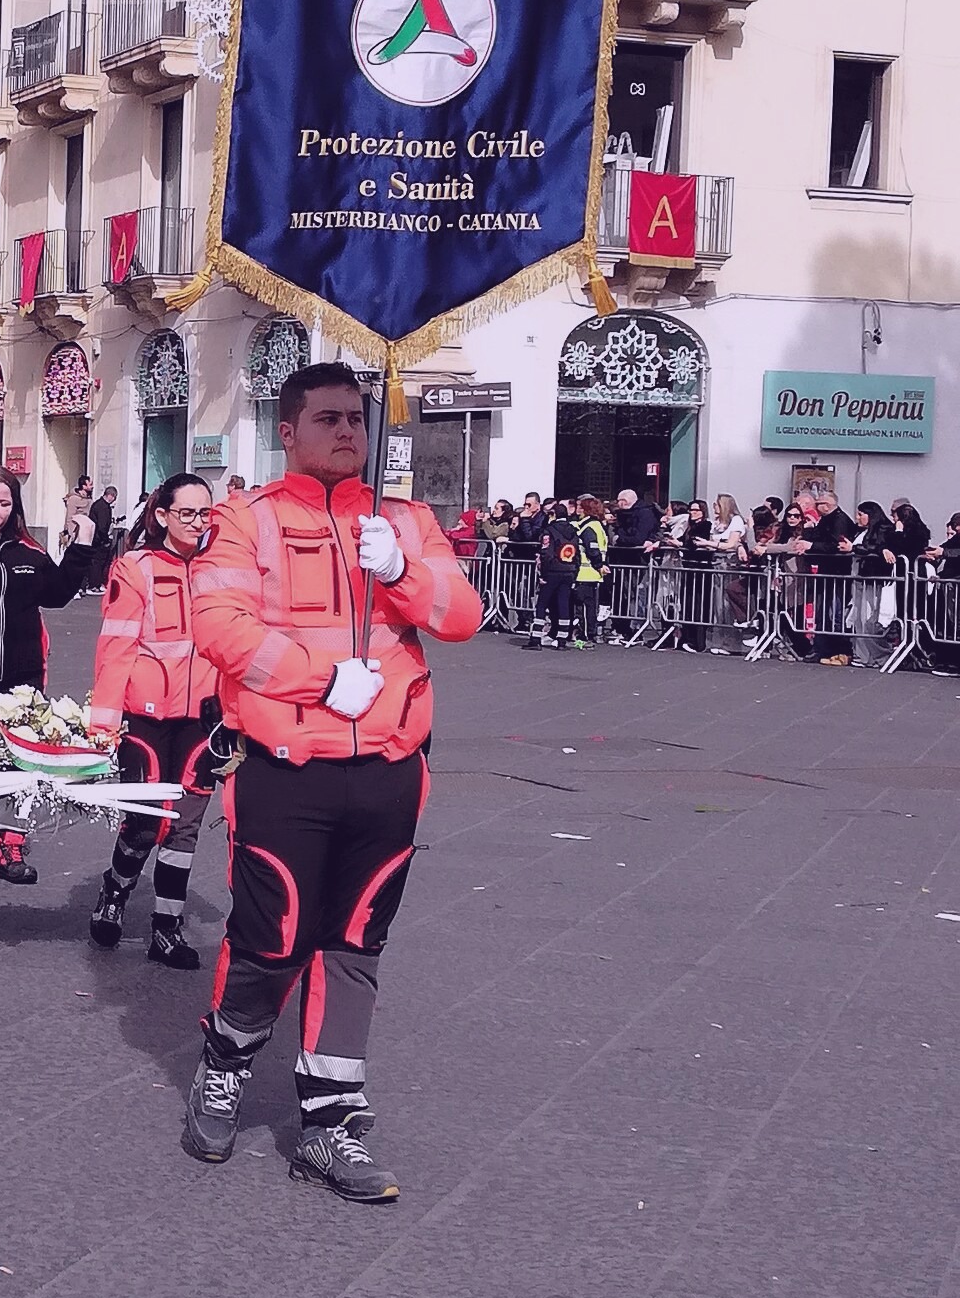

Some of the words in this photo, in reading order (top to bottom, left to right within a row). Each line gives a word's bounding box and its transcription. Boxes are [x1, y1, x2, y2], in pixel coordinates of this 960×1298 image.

[297, 130, 457, 159] Protezione
[467, 130, 545, 159] Civile
[359, 178, 378, 197] e
[388, 172, 475, 201] Sanità
[290, 211, 442, 232] MISTERBIANCO
[458, 213, 542, 231] CATANIA
[647, 195, 679, 239] A
[114, 232, 128, 272] A
[777, 389, 825, 417] Don
[831, 391, 925, 423] Peppinu
